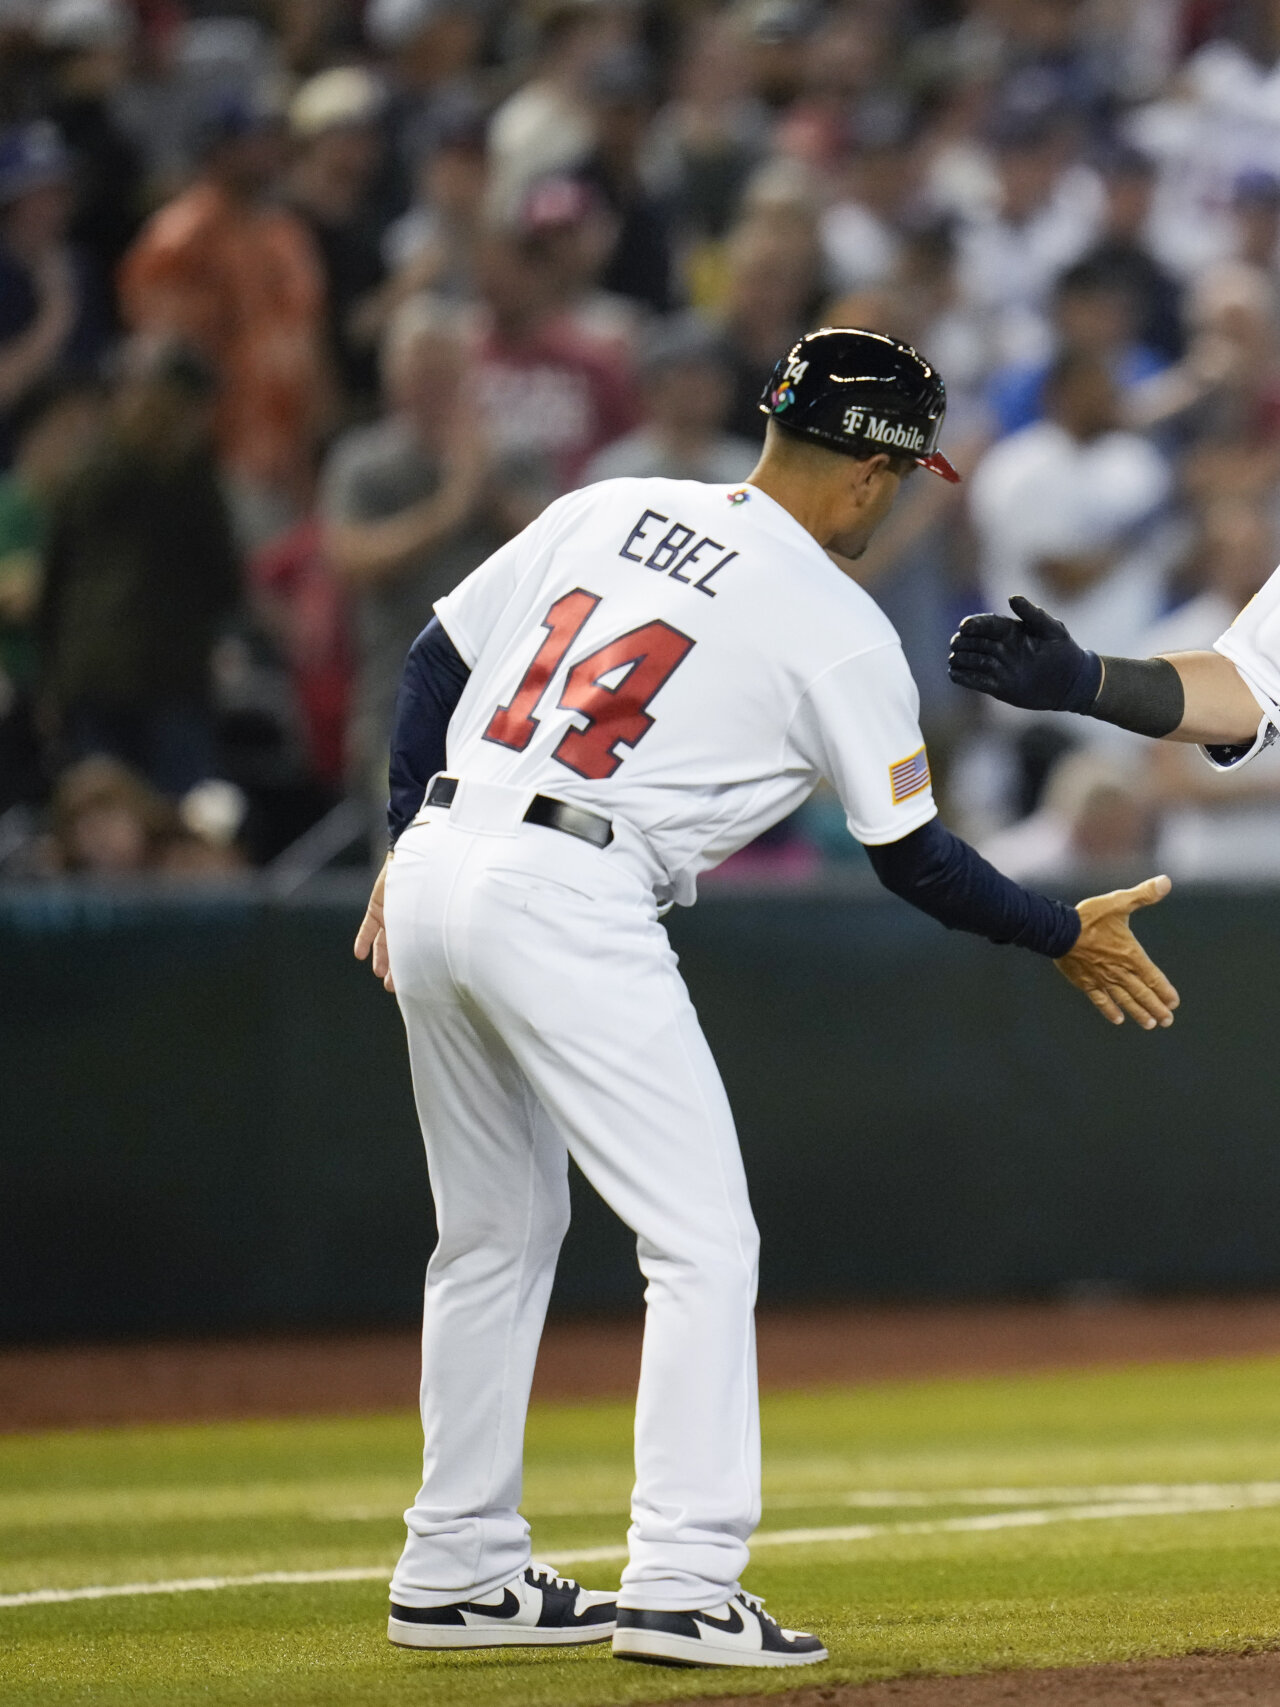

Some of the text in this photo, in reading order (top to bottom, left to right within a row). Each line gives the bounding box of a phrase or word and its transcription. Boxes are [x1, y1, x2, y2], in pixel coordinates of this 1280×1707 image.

[784, 358, 810, 384] 14
[863, 416, 925, 450] Mobile
[619, 509, 738, 597] EBEL
[482, 587, 696, 779] 14
